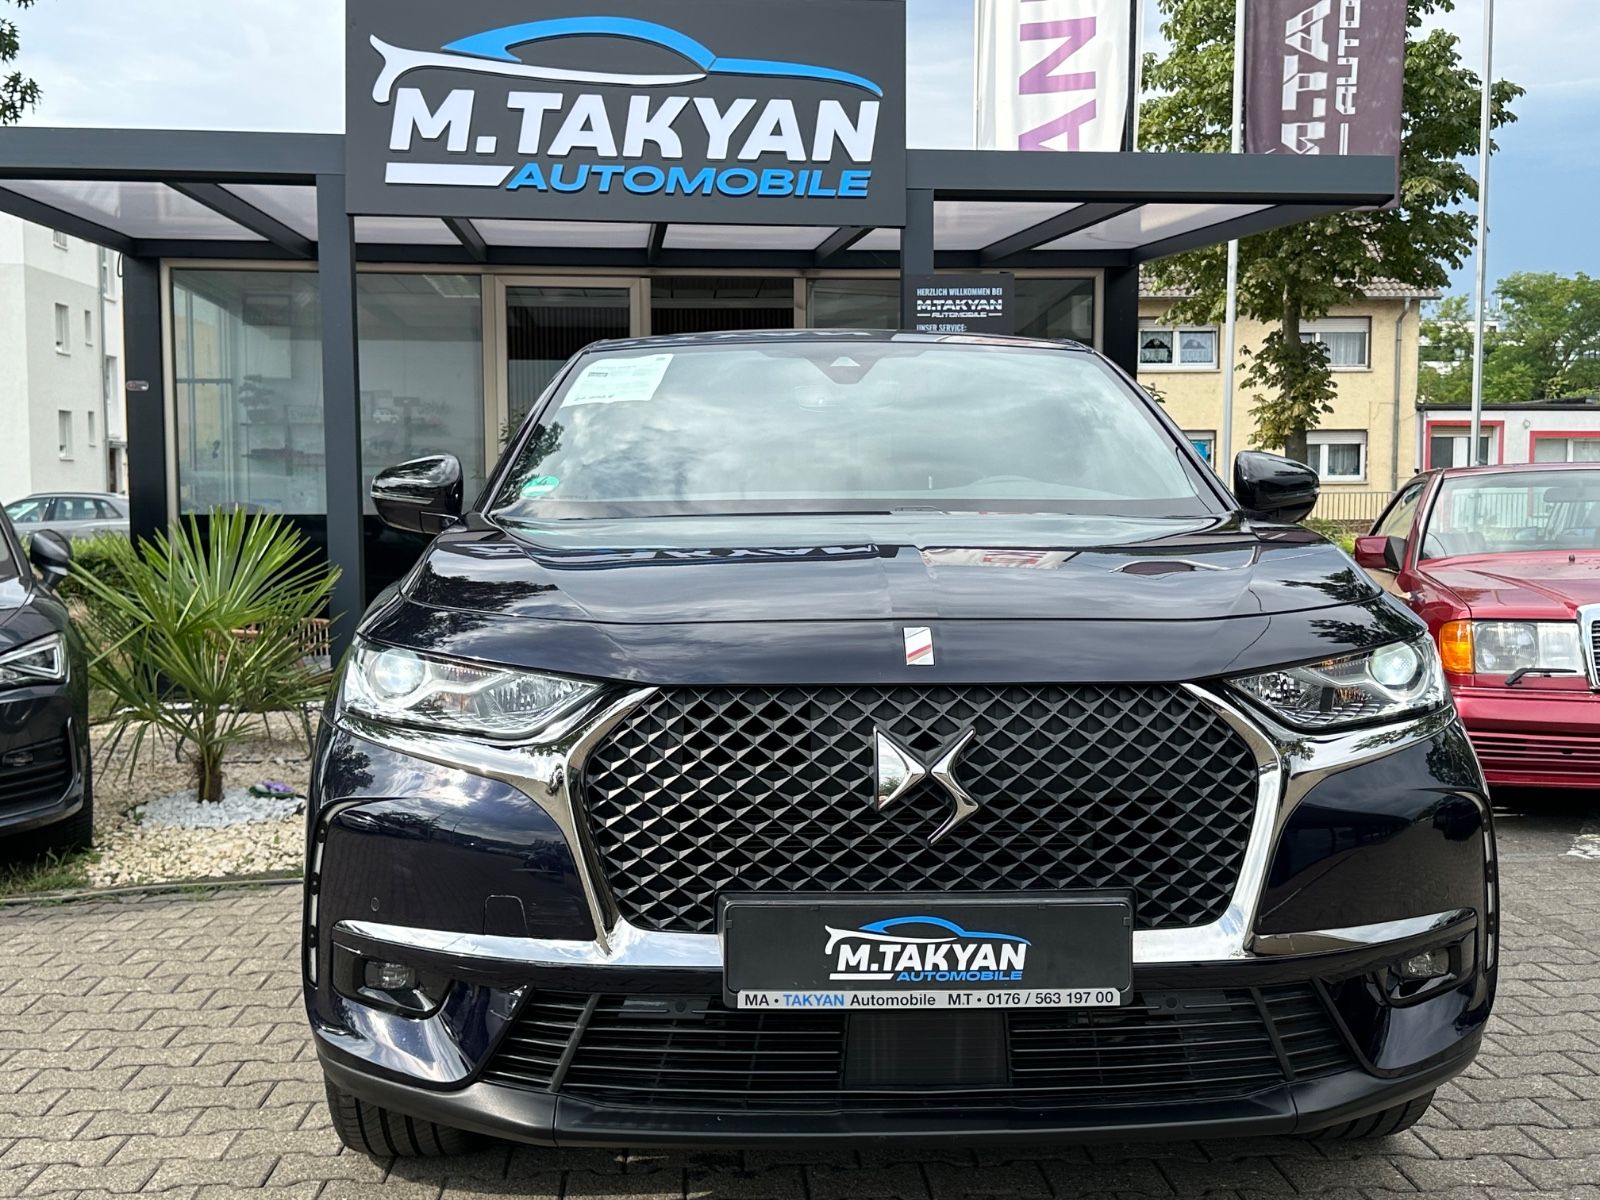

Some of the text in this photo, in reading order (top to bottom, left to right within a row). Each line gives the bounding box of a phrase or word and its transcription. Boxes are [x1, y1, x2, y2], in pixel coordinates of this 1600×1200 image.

[1019, 0, 1097, 152] AN
[389, 87, 881, 163] M.TAKYAN
[506, 163, 872, 198] AUTOMOBILE
[916, 287, 1003, 296] HERZLICH WILLKOMMEN BEI
[916, 299, 1003, 311] M.TAKYAN
[916, 323, 968, 332] UNSER SERVICE:
[836, 943, 1027, 972] M.TAKYAN
[896, 971, 1023, 982] AUTOMOBILE
[744, 994, 770, 1006] MA
[783, 994, 844, 1007] TAKYAN
[850, 993, 936, 1006] Automobile
[948, 993, 973, 1006] M.T
[986, 992, 1021, 1005] 0176
[1035, 992, 1061, 1005] 563
[1066, 991, 1091, 1004] 197
[1095, 991, 1114, 1004] 00
